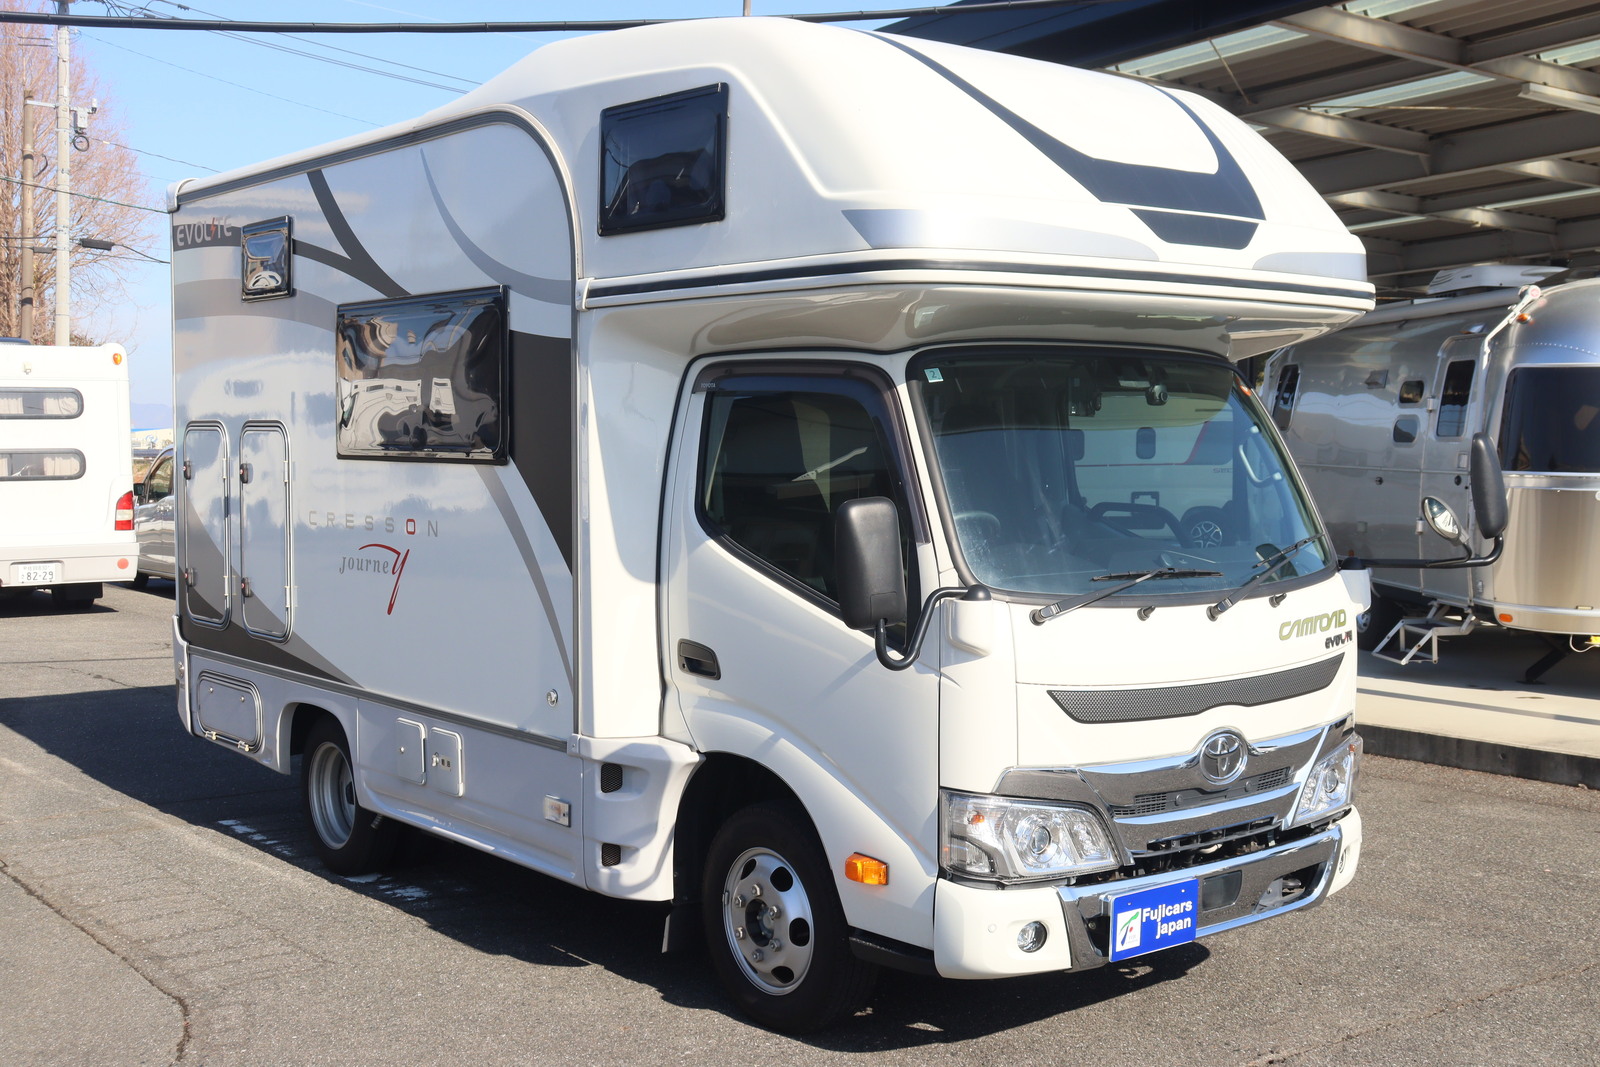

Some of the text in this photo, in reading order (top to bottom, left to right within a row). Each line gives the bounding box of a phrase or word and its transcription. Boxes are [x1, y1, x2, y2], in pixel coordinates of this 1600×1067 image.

[308, 510, 439, 538] CRESSON
[1278, 608, 1347, 641] CAMROAD
[1142, 900, 1193, 923] Fujicars
